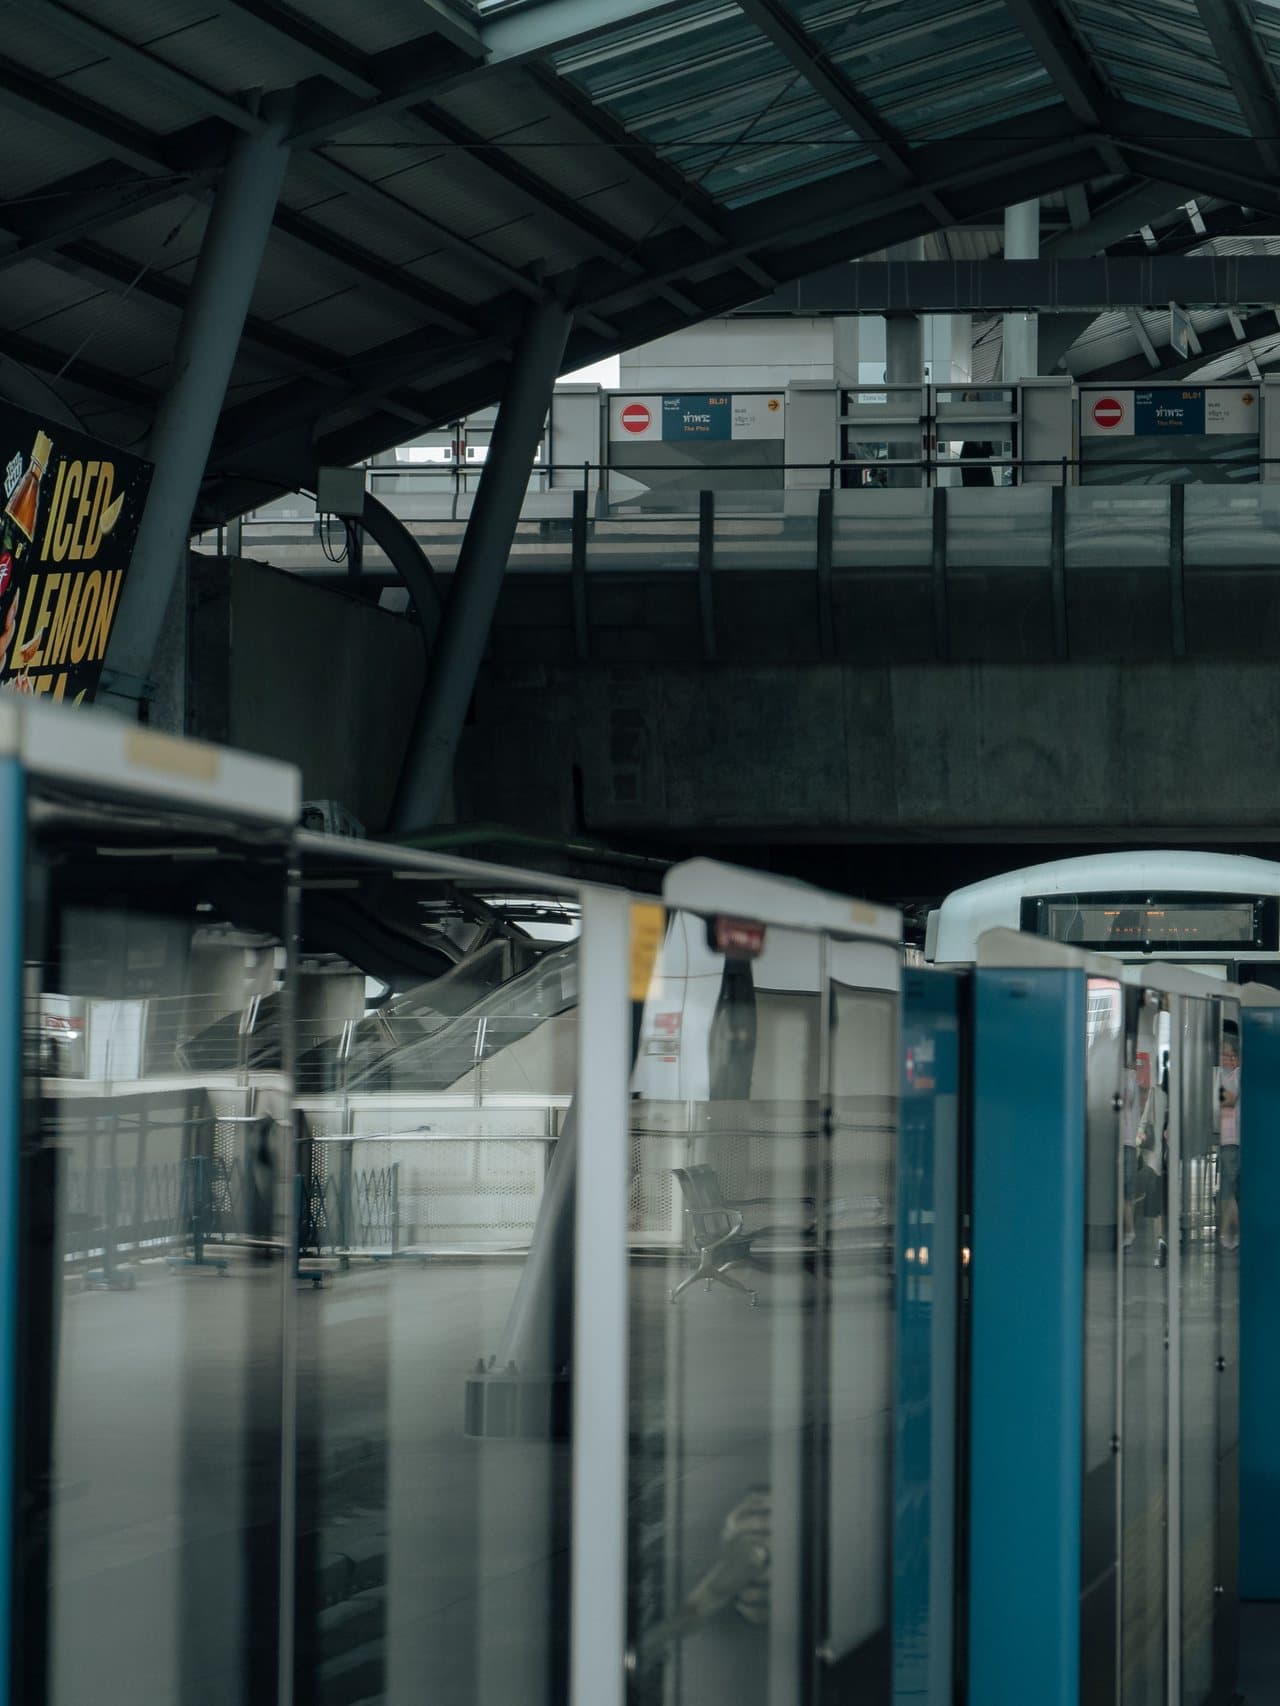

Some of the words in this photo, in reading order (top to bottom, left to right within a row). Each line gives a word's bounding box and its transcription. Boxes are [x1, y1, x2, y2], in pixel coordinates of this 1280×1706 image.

[1156, 405, 1184, 417] ท่าพระ
[40, 460, 115, 562] ICED
[9, 569, 123, 670] LEMON
